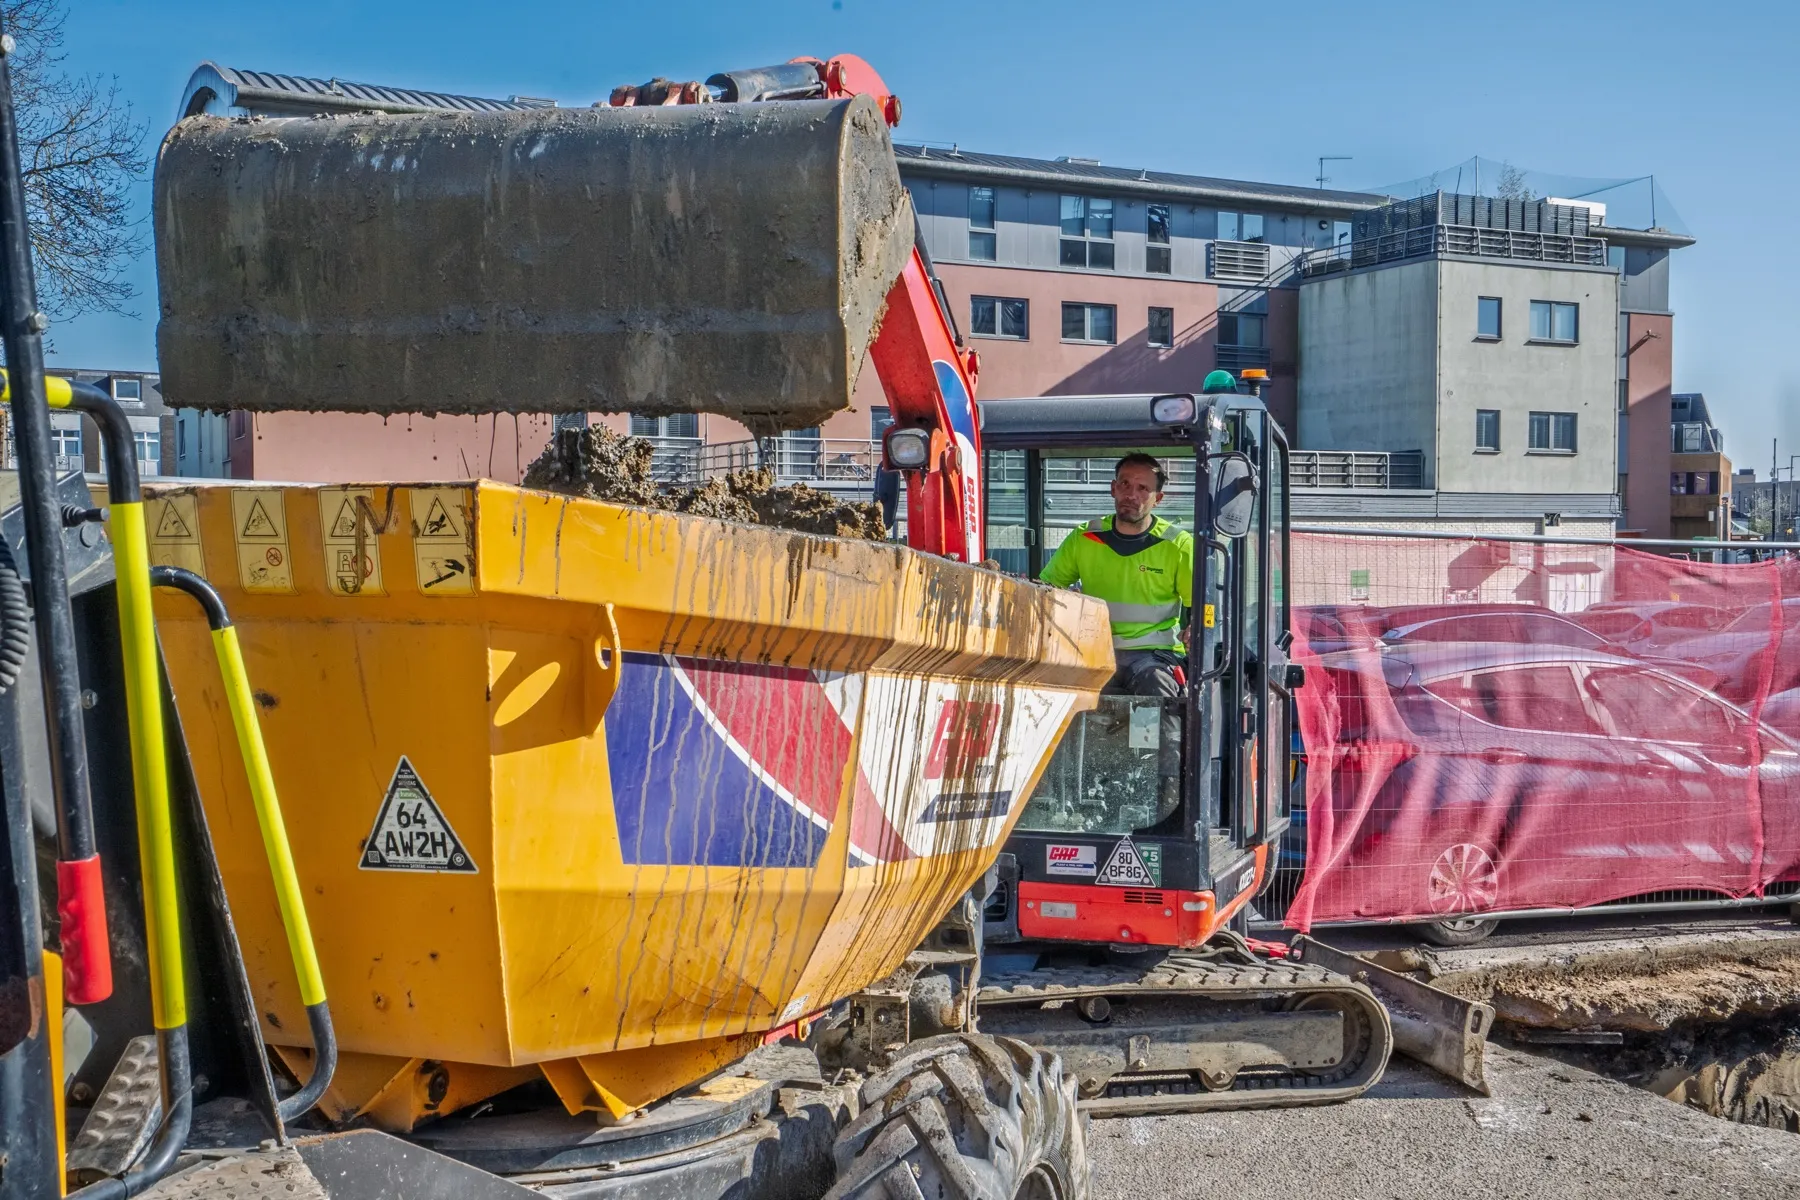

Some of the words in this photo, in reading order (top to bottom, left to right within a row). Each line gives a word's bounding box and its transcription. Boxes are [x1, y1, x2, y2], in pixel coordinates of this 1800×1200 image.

[966, 476, 977, 534] GAP
[396, 802, 427, 829] 64
[385, 831, 448, 859] AW2H
[1049, 847, 1079, 860] GAP
[1150, 851, 1159, 862] 5
[1109, 865, 1142, 879] BF8G
